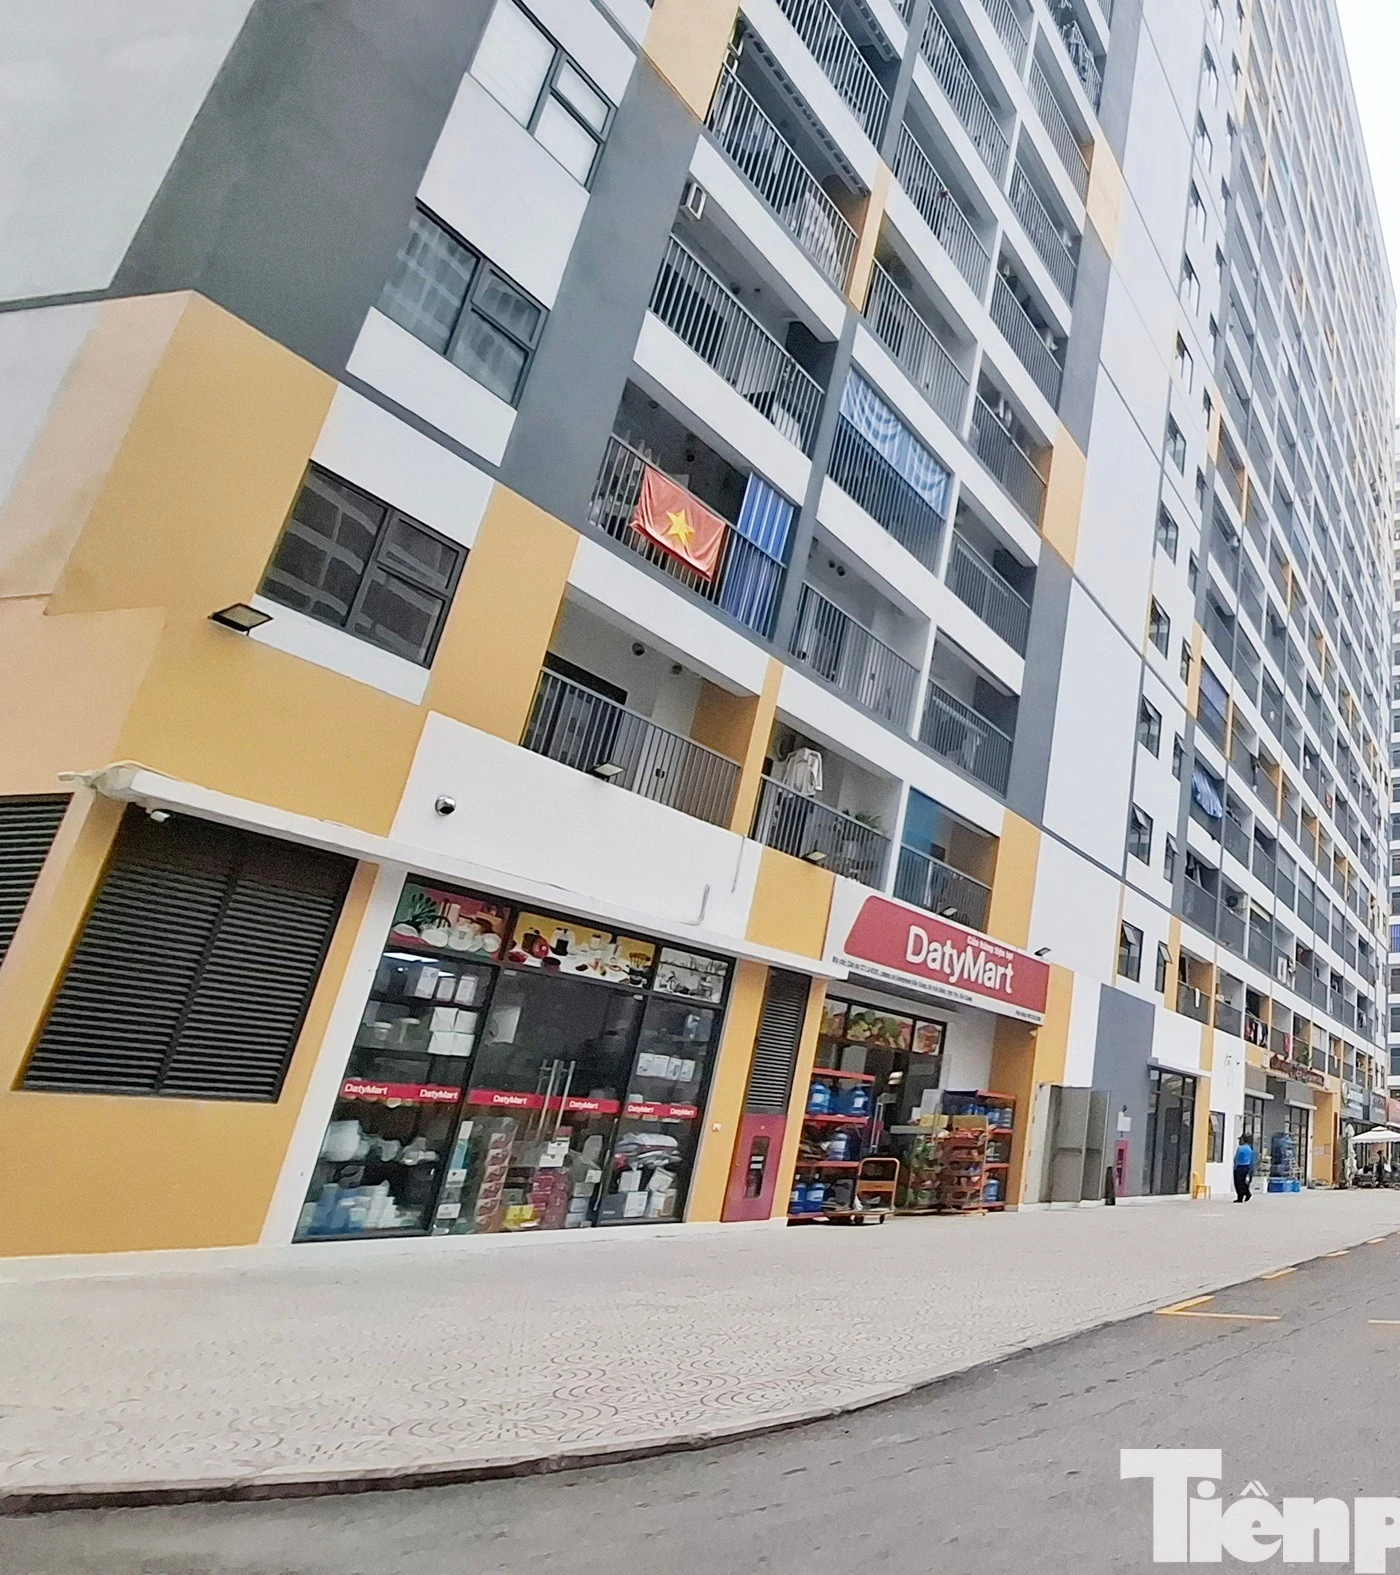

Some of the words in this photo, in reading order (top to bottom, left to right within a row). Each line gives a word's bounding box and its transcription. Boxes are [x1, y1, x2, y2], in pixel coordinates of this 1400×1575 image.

[906, 925, 1014, 994] DatyMart
[345, 1083, 388, 1095] DatyMart
[420, 1089, 458, 1100] DatyMart
[493, 1094, 527, 1105] DatyMart
[569, 1100, 598, 1110] DatyMart
